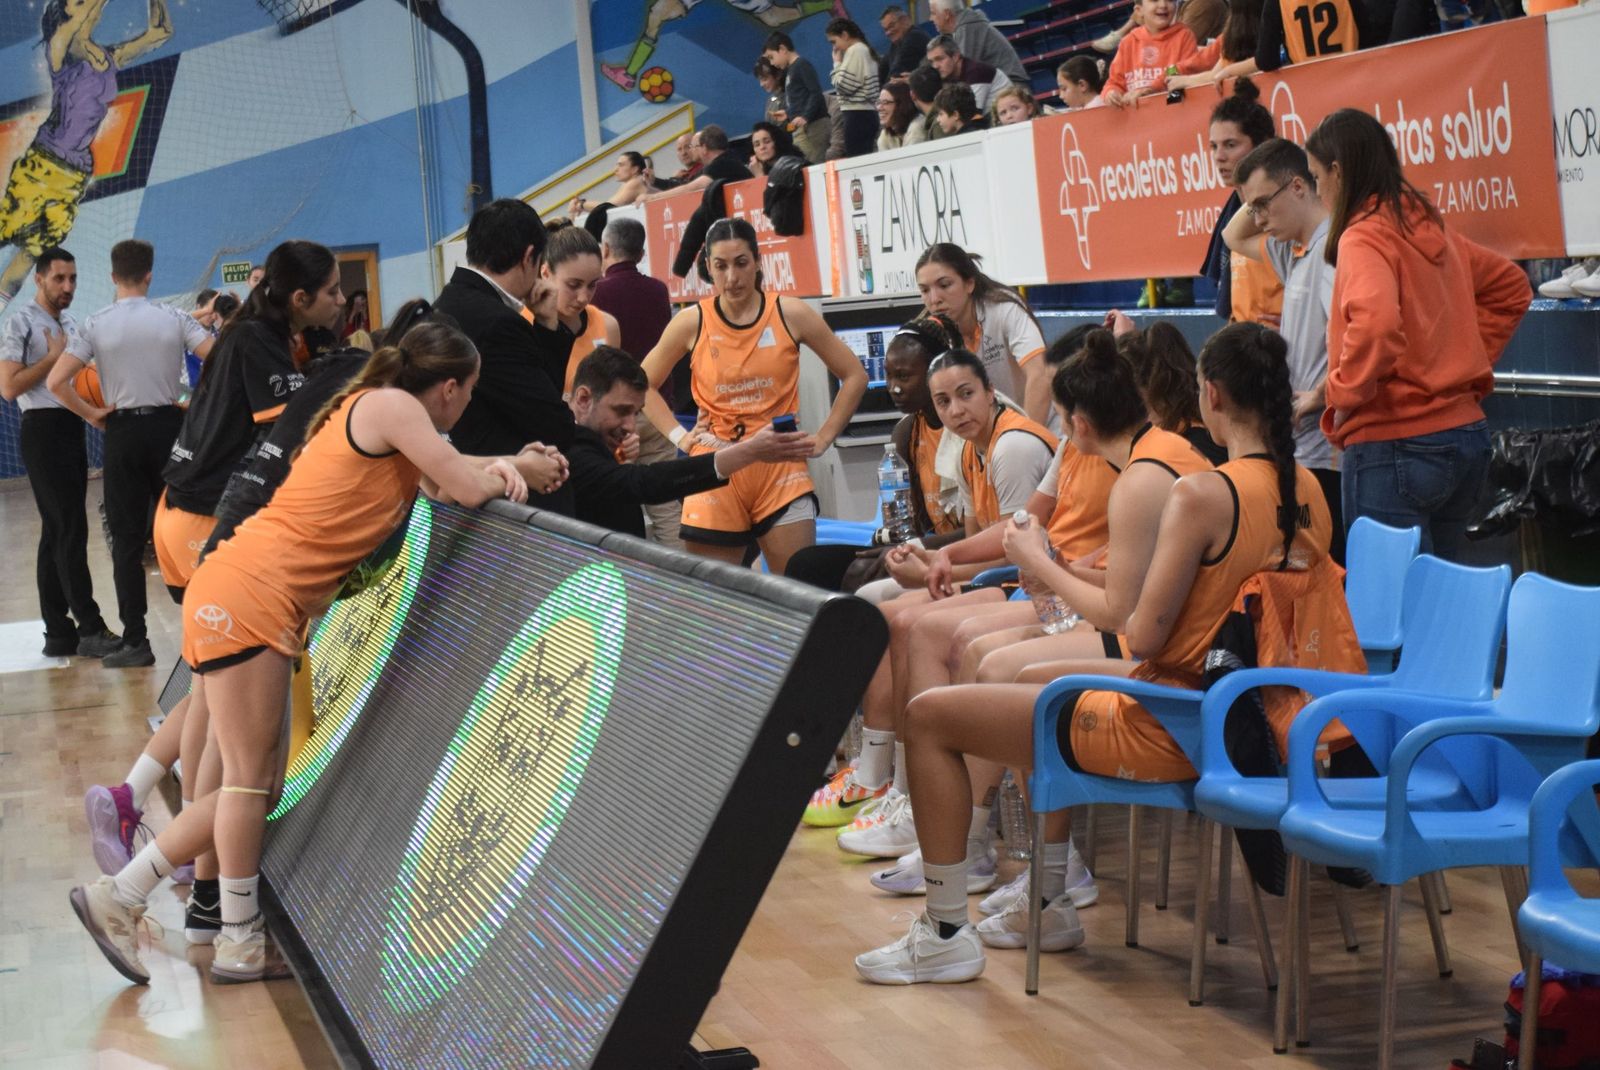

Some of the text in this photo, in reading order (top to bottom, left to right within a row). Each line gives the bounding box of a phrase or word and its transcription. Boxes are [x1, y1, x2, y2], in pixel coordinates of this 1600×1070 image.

[1294, 2, 1343, 57] 12
[1441, 80, 1513, 161] salud
[1553, 107, 1600, 159] MOR
[1100, 140, 1178, 203] recoletas
[1434, 176, 1519, 215] ZAMORA
[874, 163, 968, 254] ZAMORA
[223, 264, 250, 273] SALIDA
[715, 377, 774, 393] recoletas
[729, 391, 763, 406] salud
